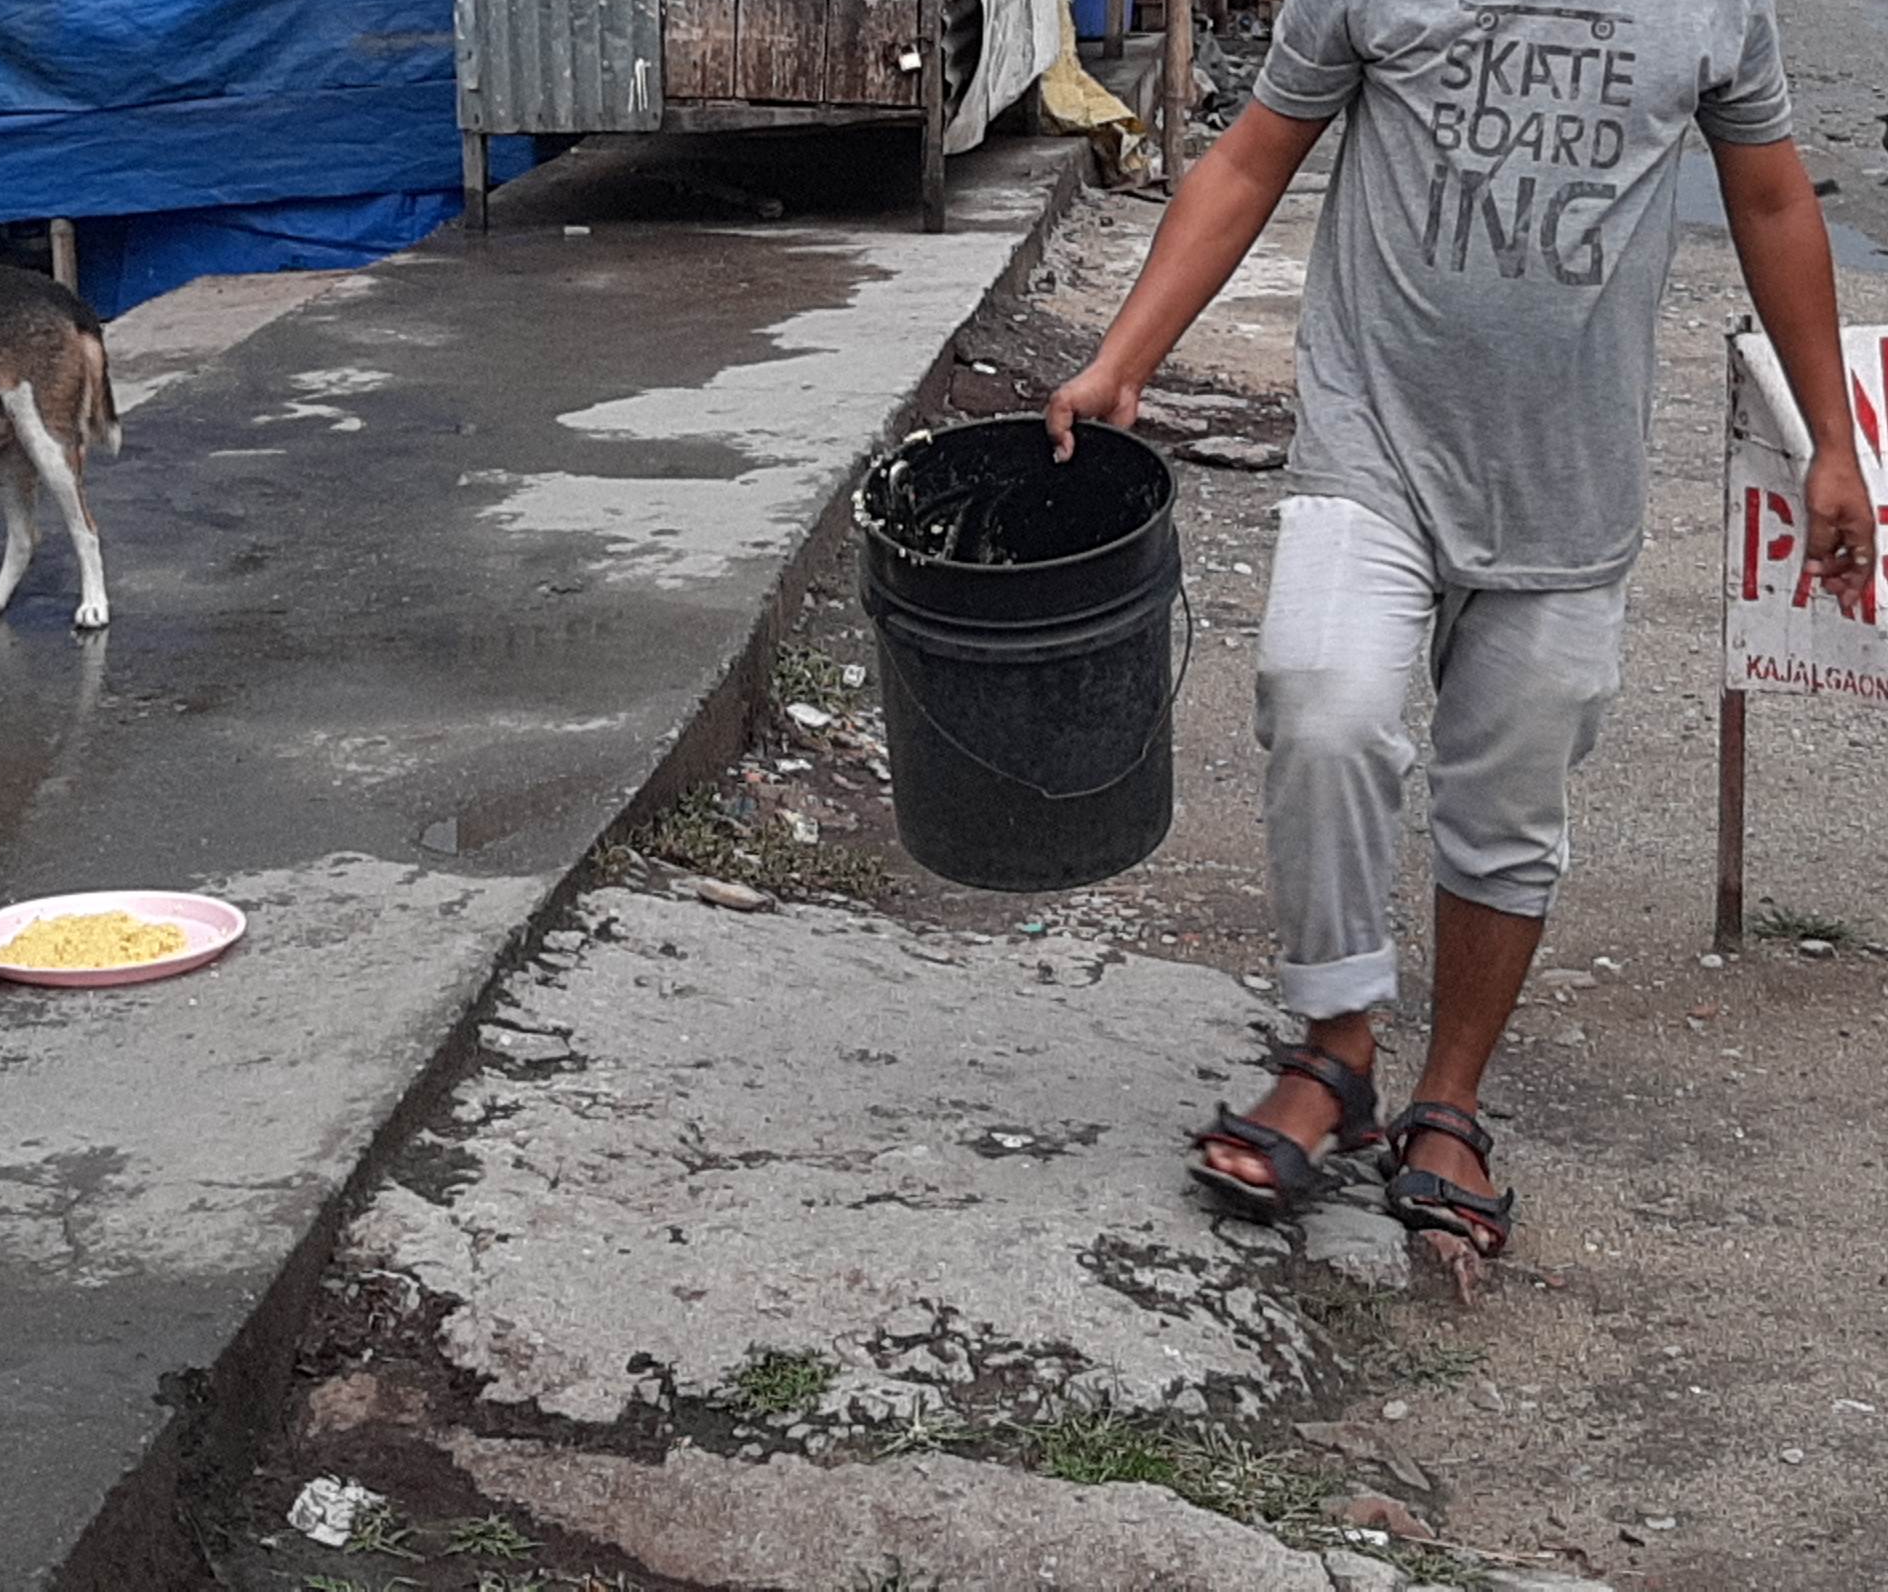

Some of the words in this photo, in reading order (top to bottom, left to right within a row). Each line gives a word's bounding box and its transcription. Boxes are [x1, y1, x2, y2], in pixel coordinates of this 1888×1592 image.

[1440, 37, 1637, 108] SKATE
[1431, 101, 1625, 169] BOARD
[1420, 164, 1618, 287] ING
